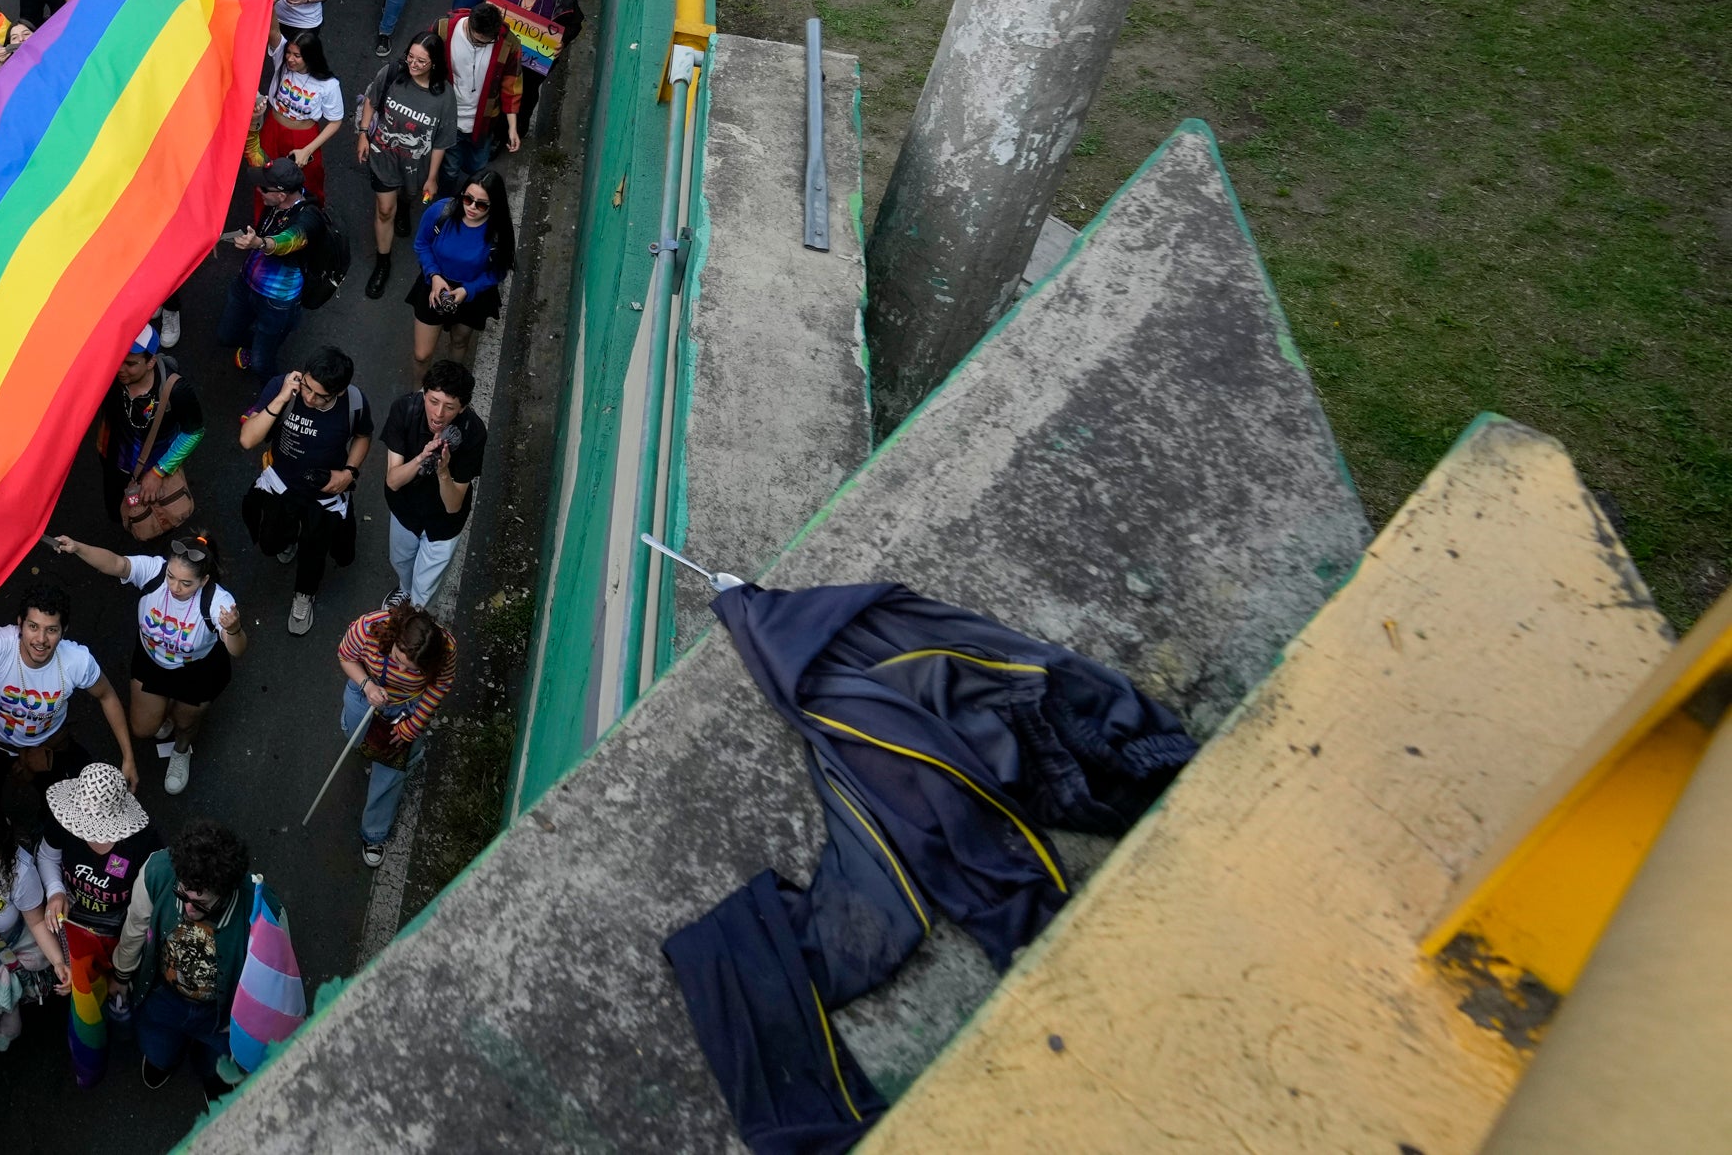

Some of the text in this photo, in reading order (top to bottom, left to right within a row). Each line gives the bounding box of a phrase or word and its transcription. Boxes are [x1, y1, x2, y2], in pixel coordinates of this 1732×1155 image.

[280, 79, 316, 106] SOY
[300, 417, 314, 428] OUT
[300, 426, 318, 437] LOVE
[145, 607, 196, 642] SOY
[1, 685, 62, 712] SOY
[75, 864, 110, 889] Find
[75, 892, 109, 912] THAT
